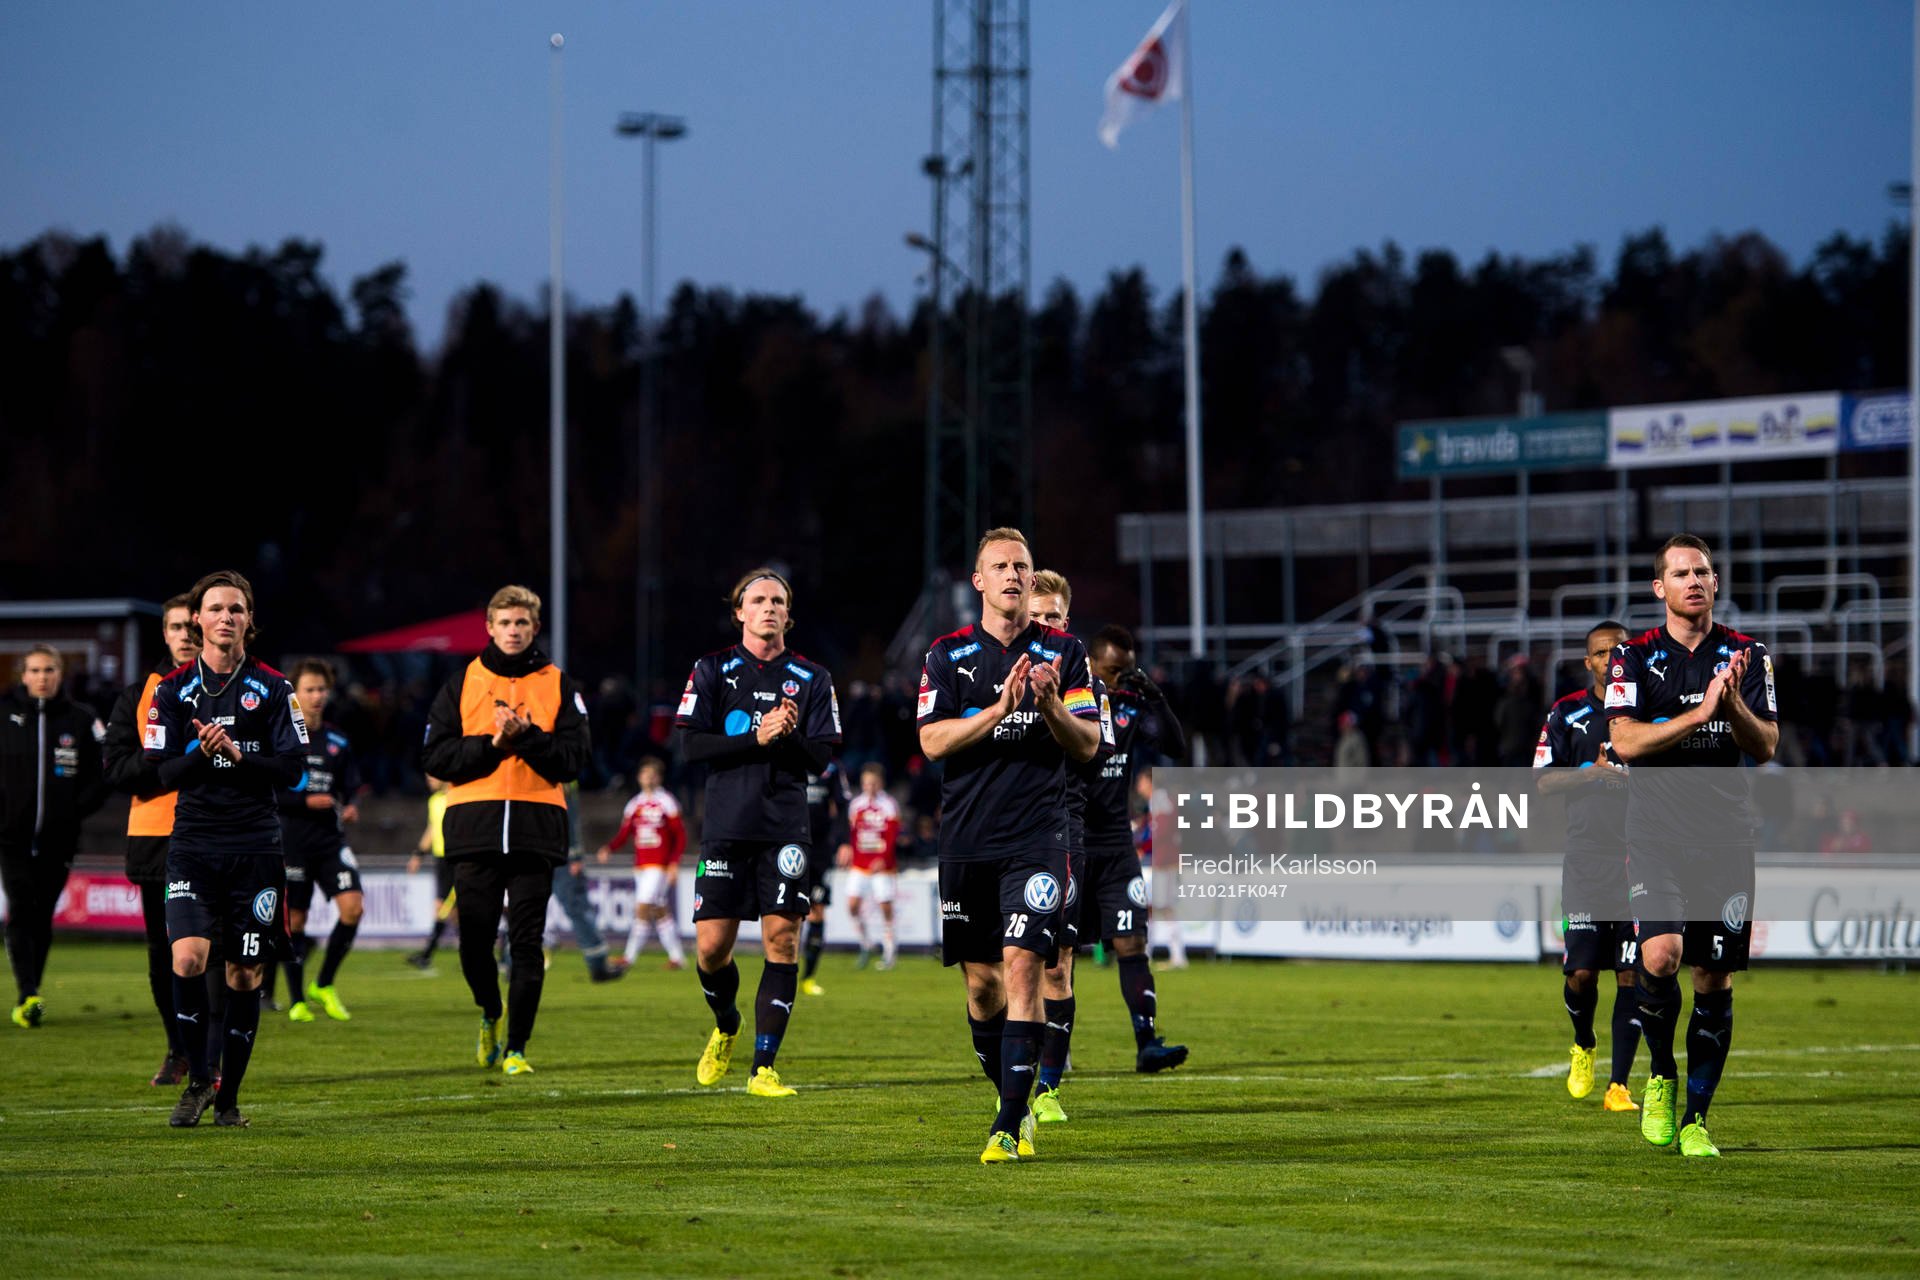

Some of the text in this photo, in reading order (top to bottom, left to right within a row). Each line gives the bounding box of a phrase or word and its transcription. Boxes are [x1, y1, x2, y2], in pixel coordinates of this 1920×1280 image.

[1101, 767, 1123, 777] ank
[705, 860, 728, 870] Solid
[168, 881, 190, 893] Solid
[777, 883, 786, 904] 2
[943, 900, 960, 912] olid
[1005, 914, 1028, 938] 26
[1117, 910, 1132, 930] 21
[1302, 905, 1453, 945] Volkswagen
[1569, 912, 1591, 923] Solid
[242, 933, 260, 956] 15
[1621, 940, 1636, 964] 14
[1712, 935, 1723, 960] 5
